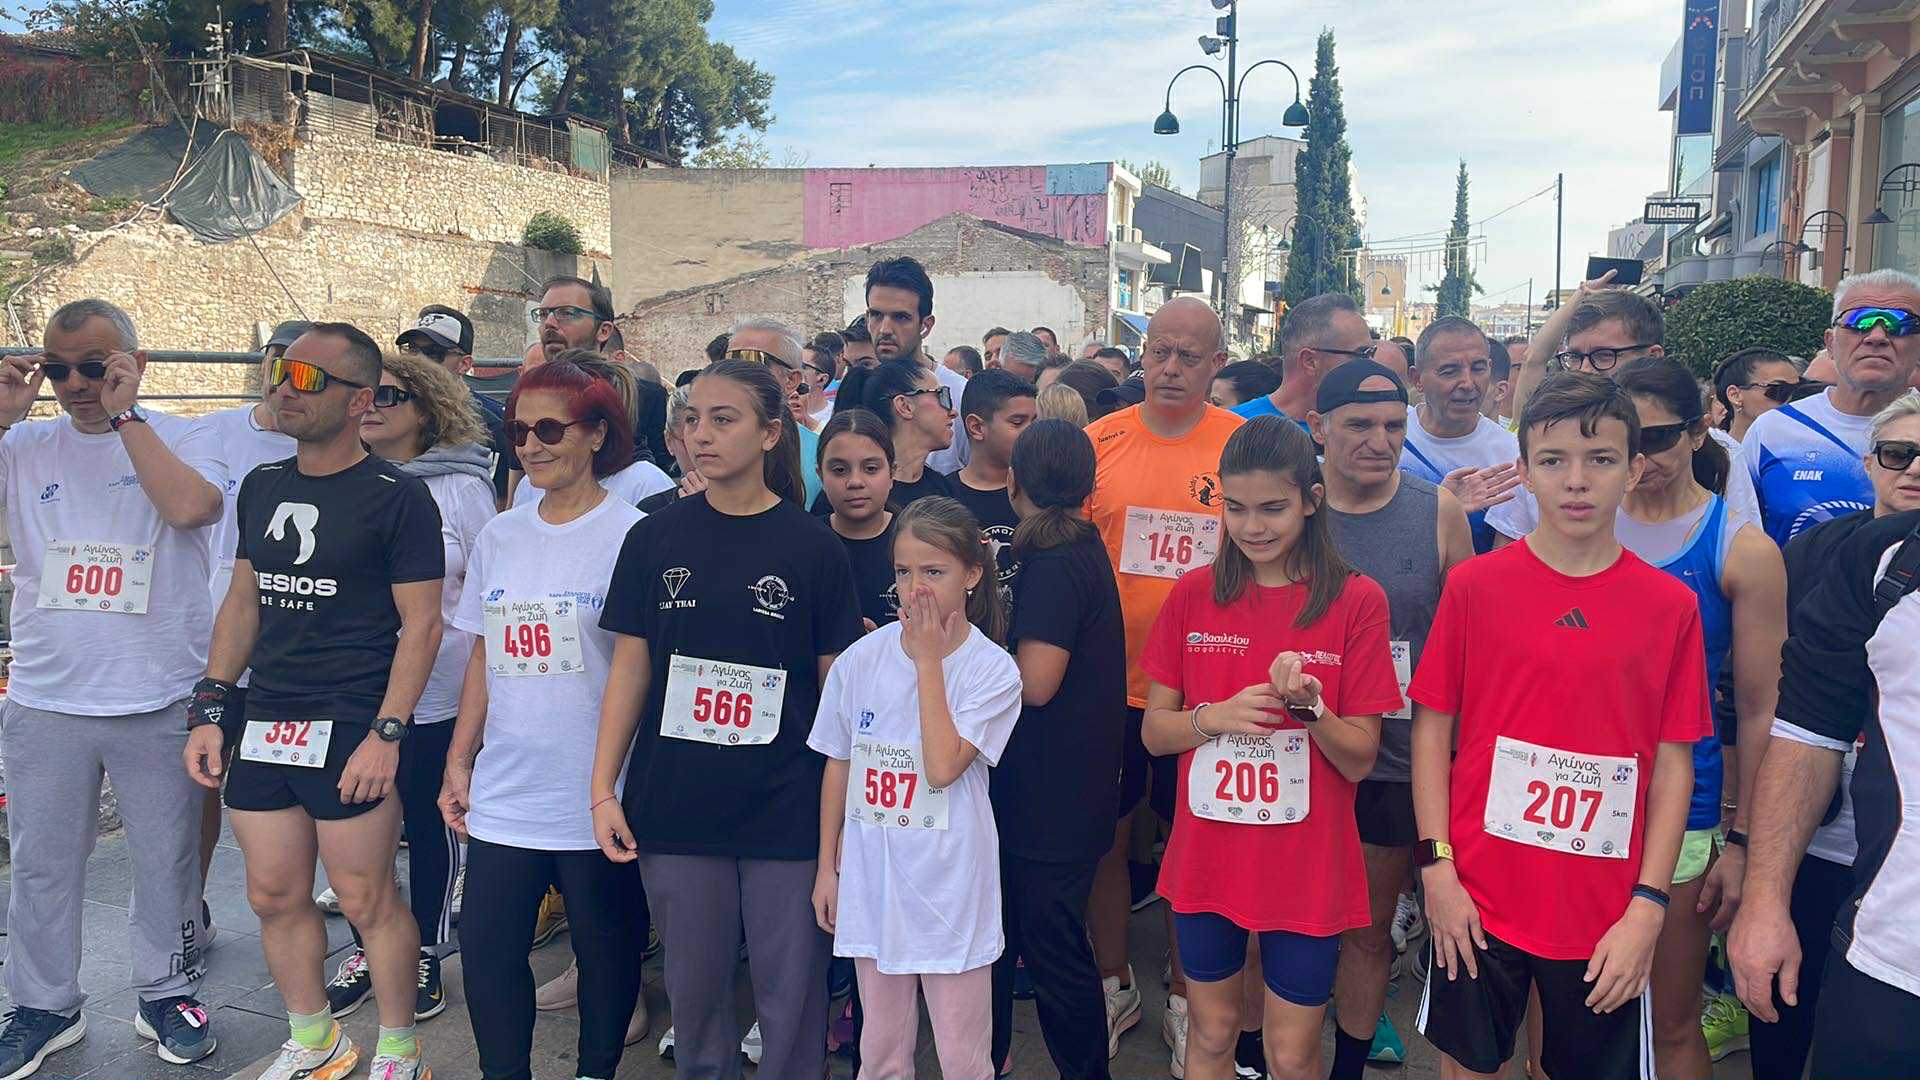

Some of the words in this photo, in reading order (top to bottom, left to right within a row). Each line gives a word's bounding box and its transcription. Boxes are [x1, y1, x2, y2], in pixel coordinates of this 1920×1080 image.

[1792, 470, 1823, 481] ENAK
[1149, 532, 1193, 565] 146
[66, 564, 123, 596] 600
[261, 596, 273, 606] BE
[280, 599, 314, 611] SAFE
[504, 623, 552, 658] 496
[711, 664, 752, 681] Αγώνας
[729, 677, 753, 692] Ζωή
[693, 686, 753, 729] 566
[761, 710, 776, 719] 5km
[265, 720, 312, 747] 352
[1226, 734, 1271, 748] Αγώνας
[876, 743, 911, 759] Αγώνας
[1249, 746, 1275, 760] Ζωή
[891, 757, 915, 771] Ζωή
[1547, 753, 1600, 775] Αγώνας
[1215, 759, 1279, 804] 206
[1572, 770, 1602, 788] Ζωή
[865, 767, 918, 809] 587
[1523, 780, 1604, 833] 207
[1612, 810, 1628, 818] 5km
